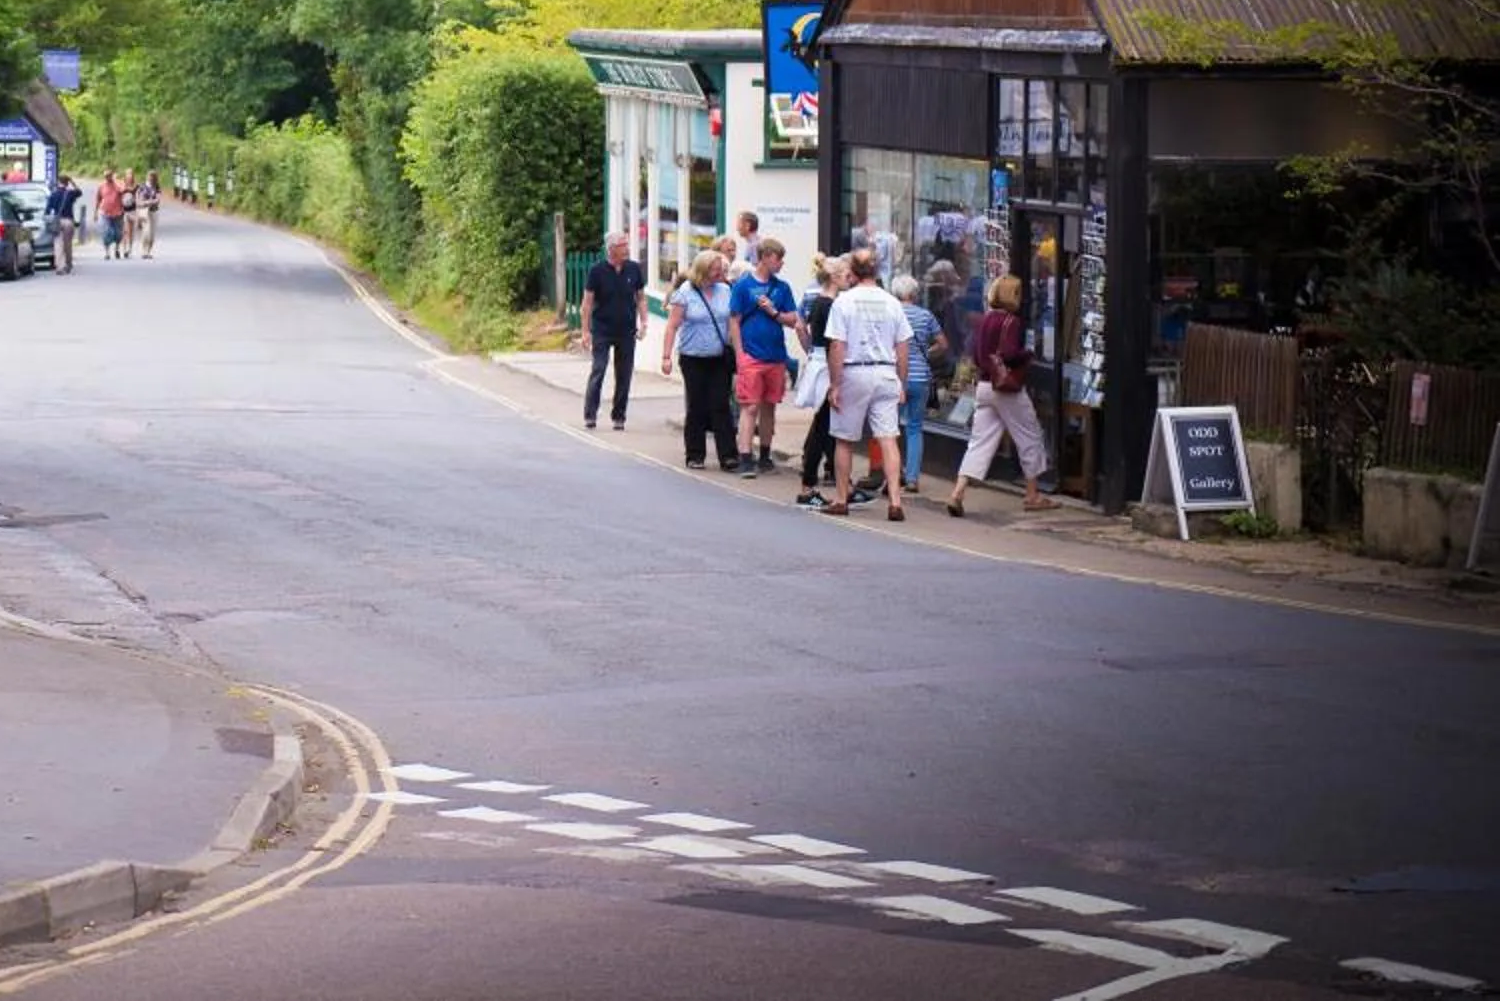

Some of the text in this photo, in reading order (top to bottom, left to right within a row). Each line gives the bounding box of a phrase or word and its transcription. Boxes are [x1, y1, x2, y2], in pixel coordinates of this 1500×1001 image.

[1187, 426, 1219, 439] ODD
[1188, 444, 1225, 457] SPOT
[1189, 475, 1235, 491] Gallery
